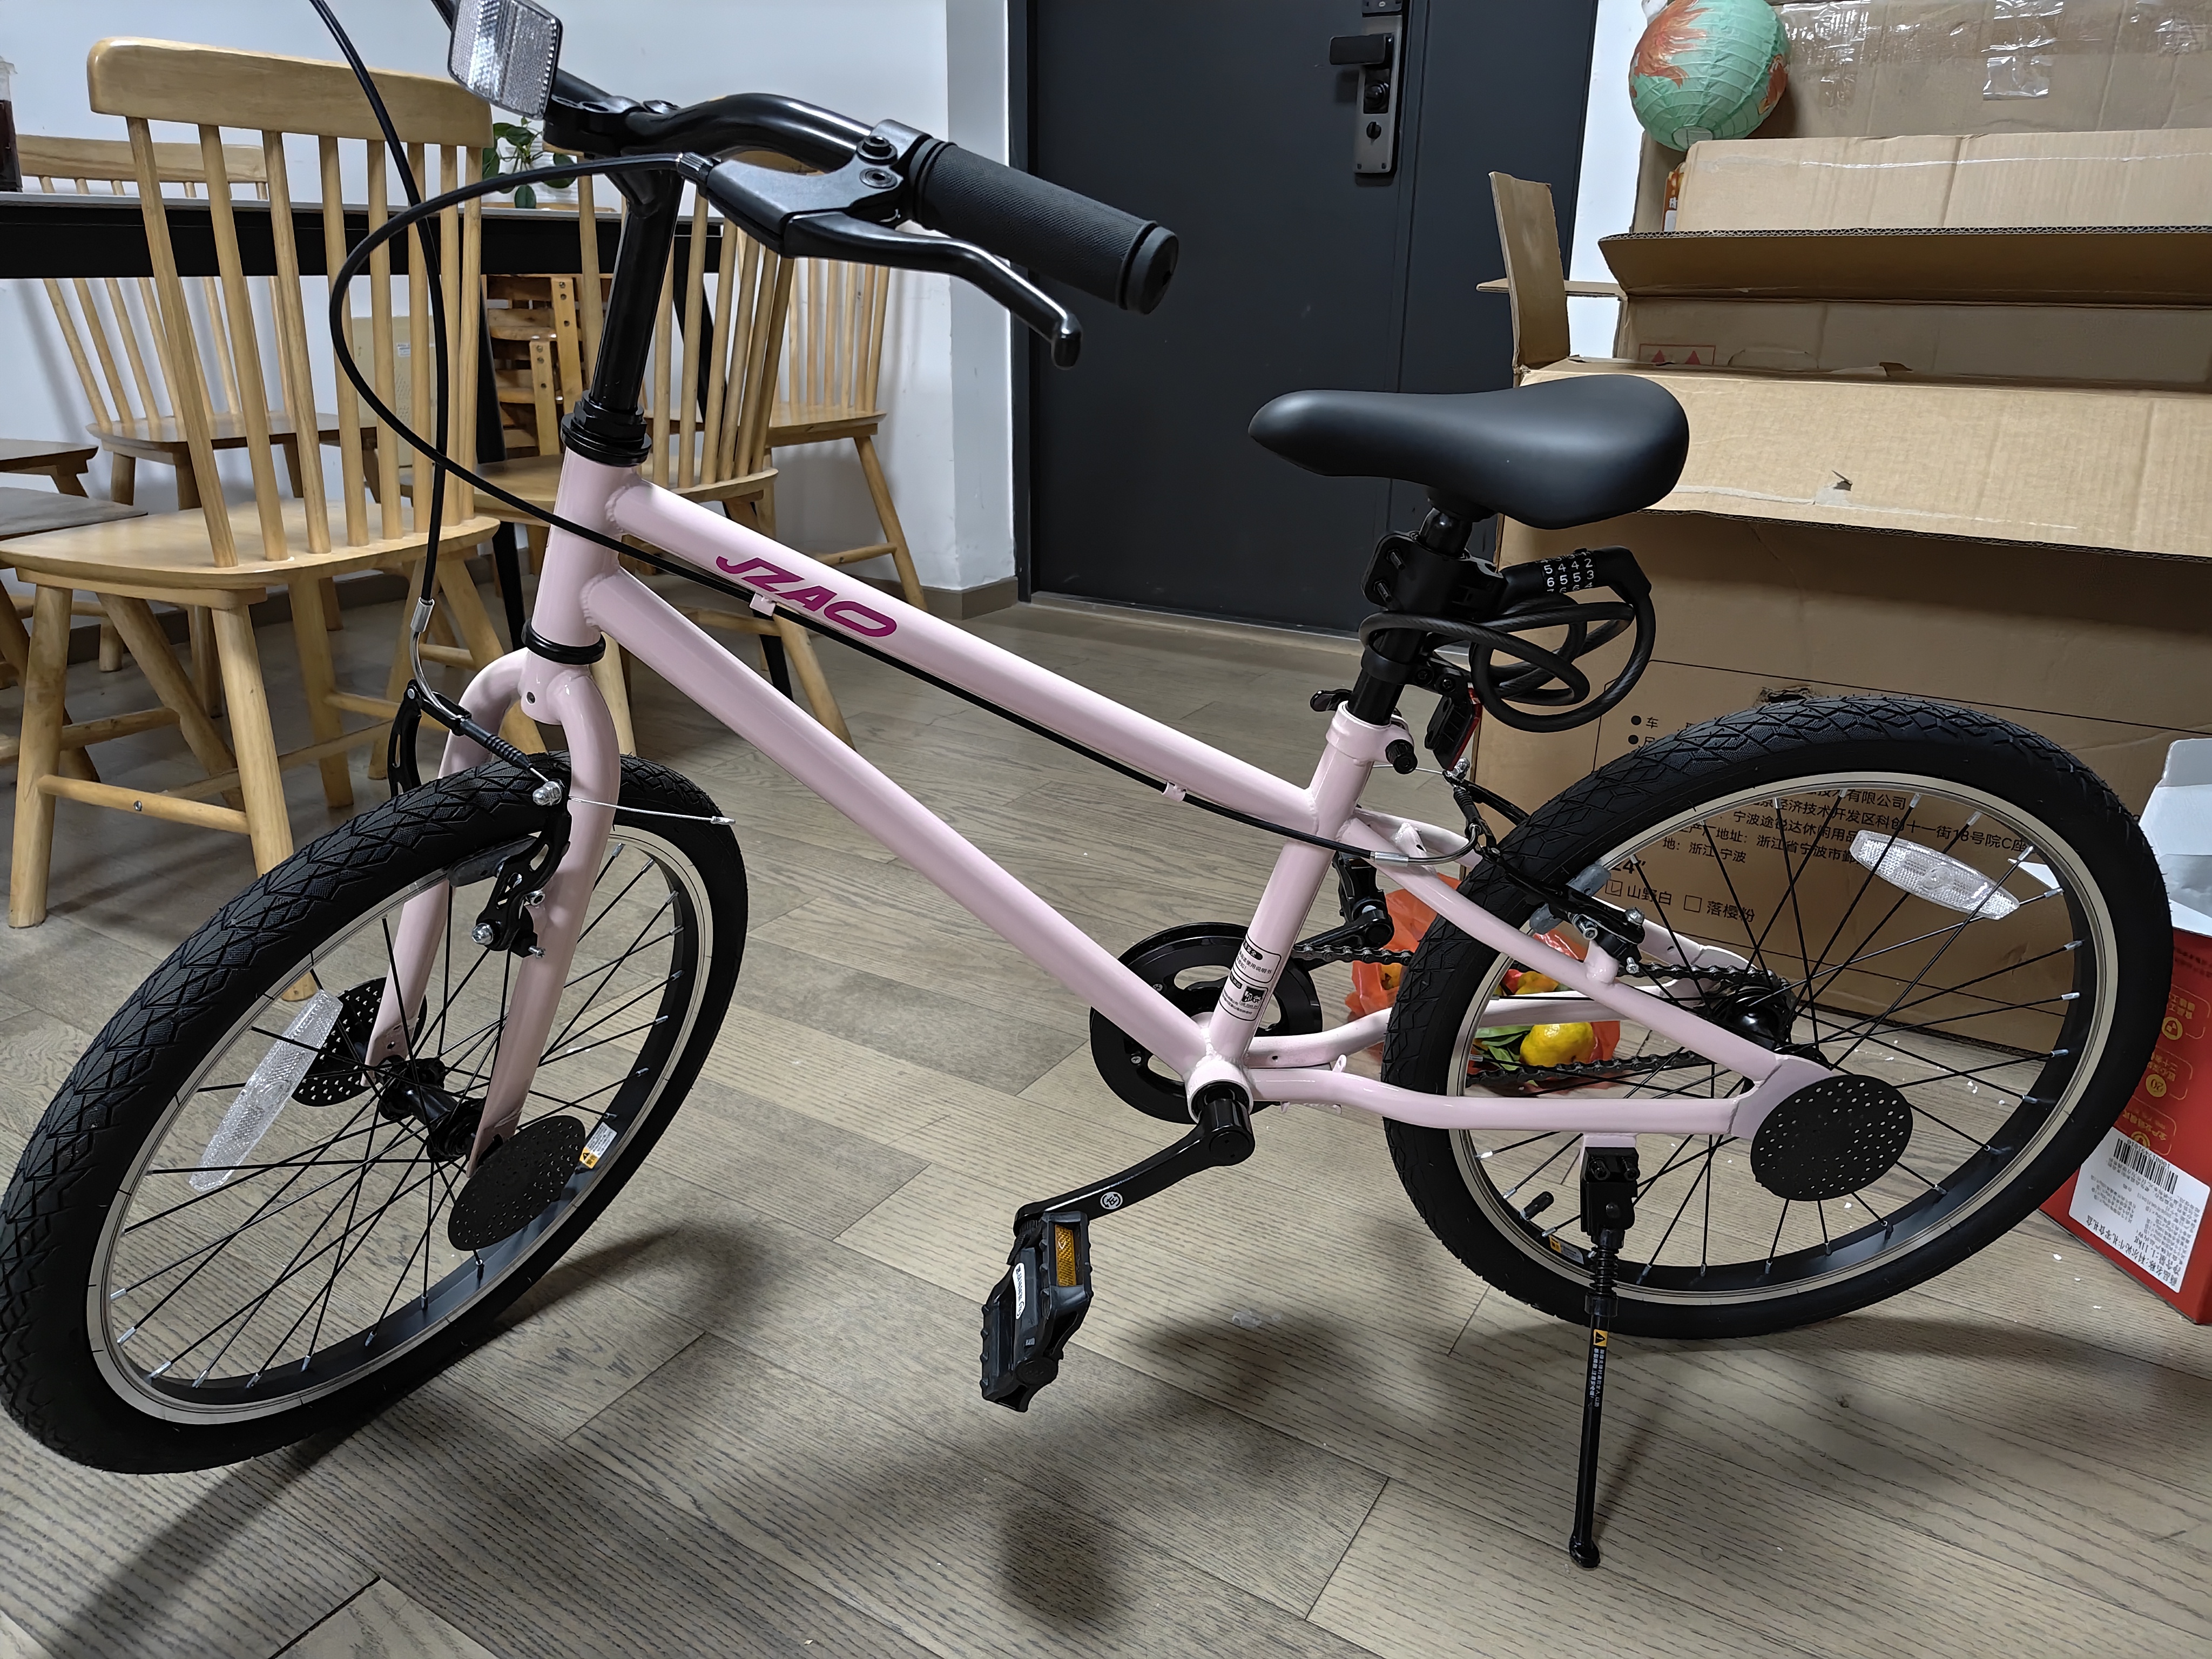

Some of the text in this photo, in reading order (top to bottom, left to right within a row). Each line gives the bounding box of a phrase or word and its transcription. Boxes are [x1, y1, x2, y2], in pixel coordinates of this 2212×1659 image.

[716, 556, 897, 637] JZAO
[1645, 716, 1659, 729] 车
[1752, 798, 2027, 852] 京经济技术开发区科创十一街18号院C座
[1627, 885, 1672, 906] 山野白
[2149, 1078, 2164, 1093] 20
